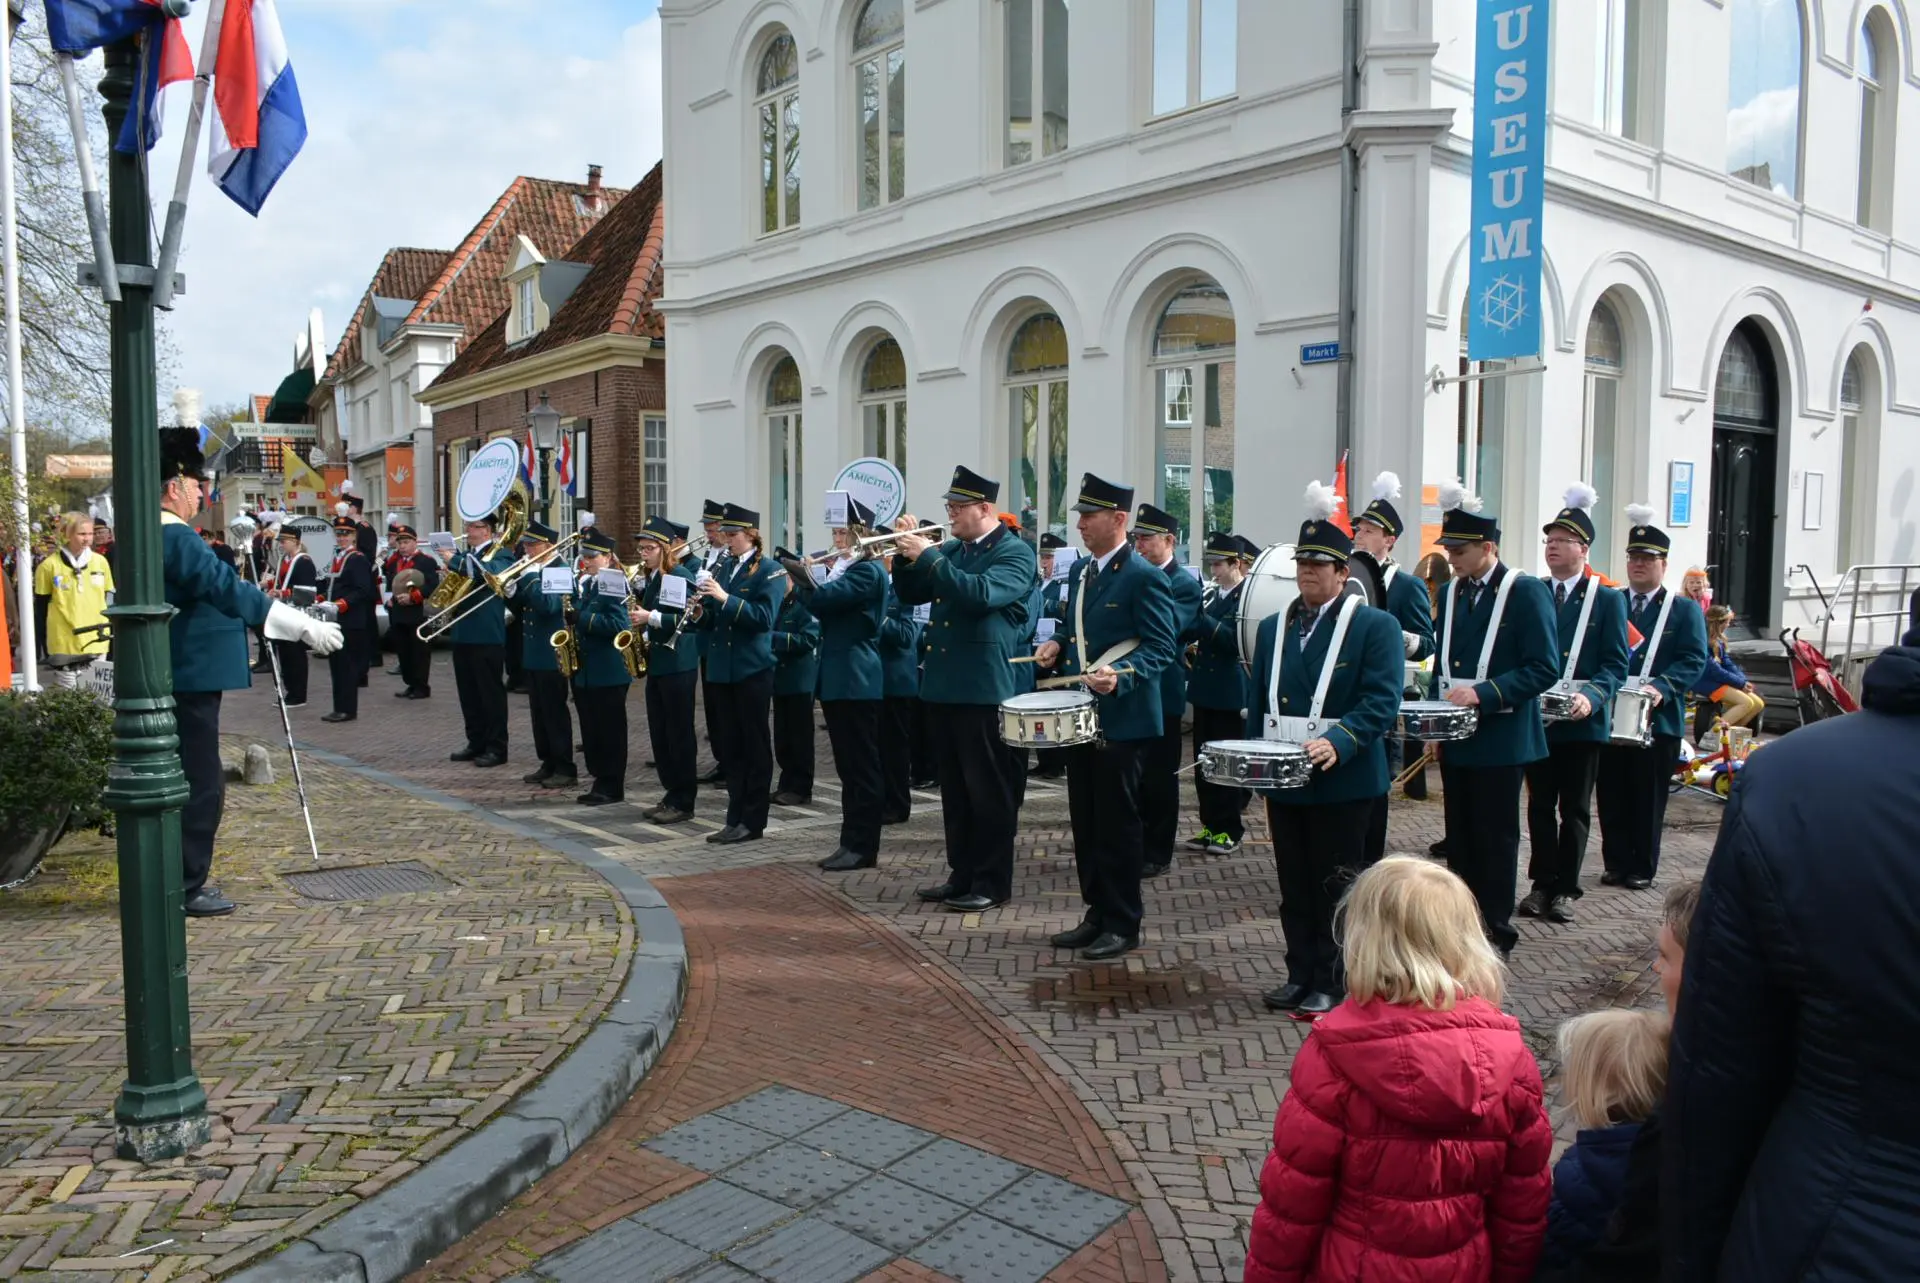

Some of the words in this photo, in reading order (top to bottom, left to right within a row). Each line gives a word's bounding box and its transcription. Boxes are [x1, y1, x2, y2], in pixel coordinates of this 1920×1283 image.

[1480, 0, 1533, 263] USEUM
[1308, 347, 1335, 359] Markt
[472, 458, 509, 470] AMICITIA
[847, 471, 893, 491] AMICITIA
